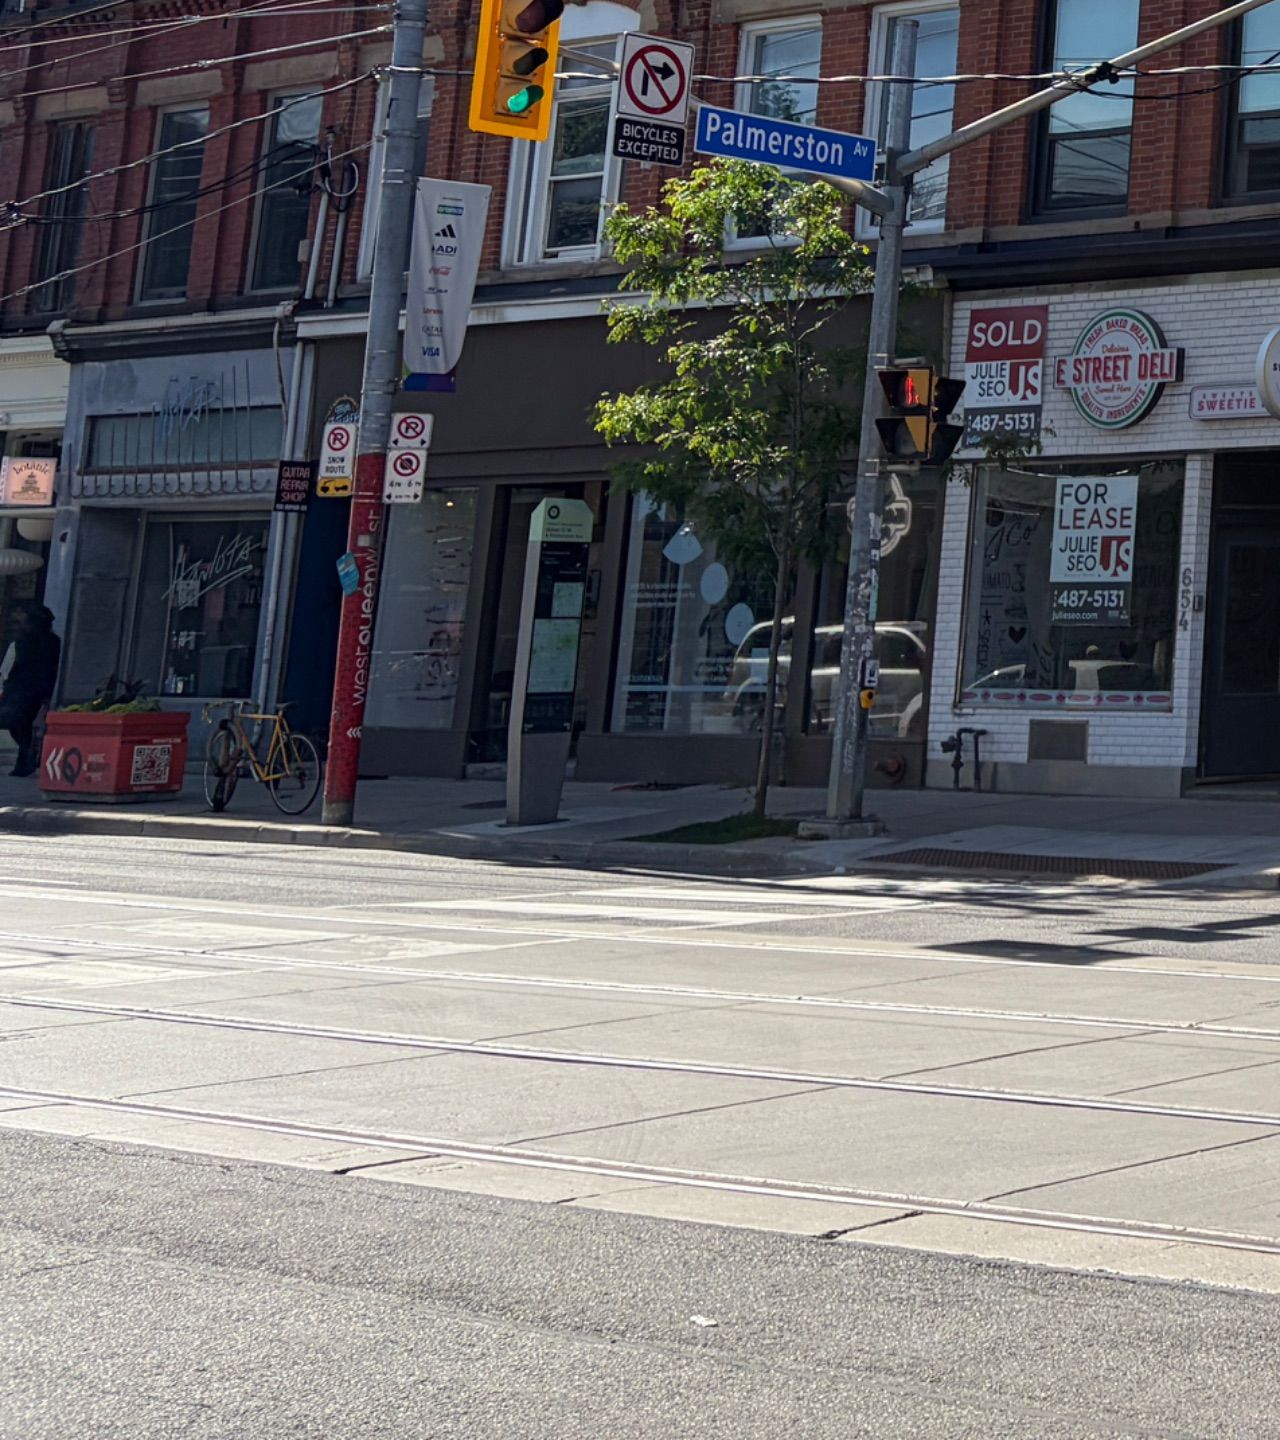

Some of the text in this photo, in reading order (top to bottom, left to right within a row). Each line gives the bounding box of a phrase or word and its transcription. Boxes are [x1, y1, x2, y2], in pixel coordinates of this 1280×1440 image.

[622, 123, 677, 145] BICYCLES
[705, 112, 868, 166] Palmerston Av
[618, 139, 679, 161] EXCEPTED
[971, 319, 1042, 348] SOLD
[971, 362, 1007, 380] JULIE
[1057, 351, 1174, 385] E STREET DELI
[978, 380, 1006, 398] SEO
[1197, 398, 1256, 412] SWEETIE
[971, 413, 1035, 432] 487-5131
[325, 465, 345, 474] ROUTE
[327, 456, 345, 465] SNOW
[281, 466, 310, 479] GUITAR
[279, 479, 309, 491] REPAIR
[1060, 483, 1108, 505] FOR
[280, 491, 306, 503] SHOP
[1058, 507, 1133, 530] LEASE
[1059, 536, 1099, 553] JULIE
[1066, 554, 1097, 572] SEO
[1057, 589, 1124, 607] 487-5131
